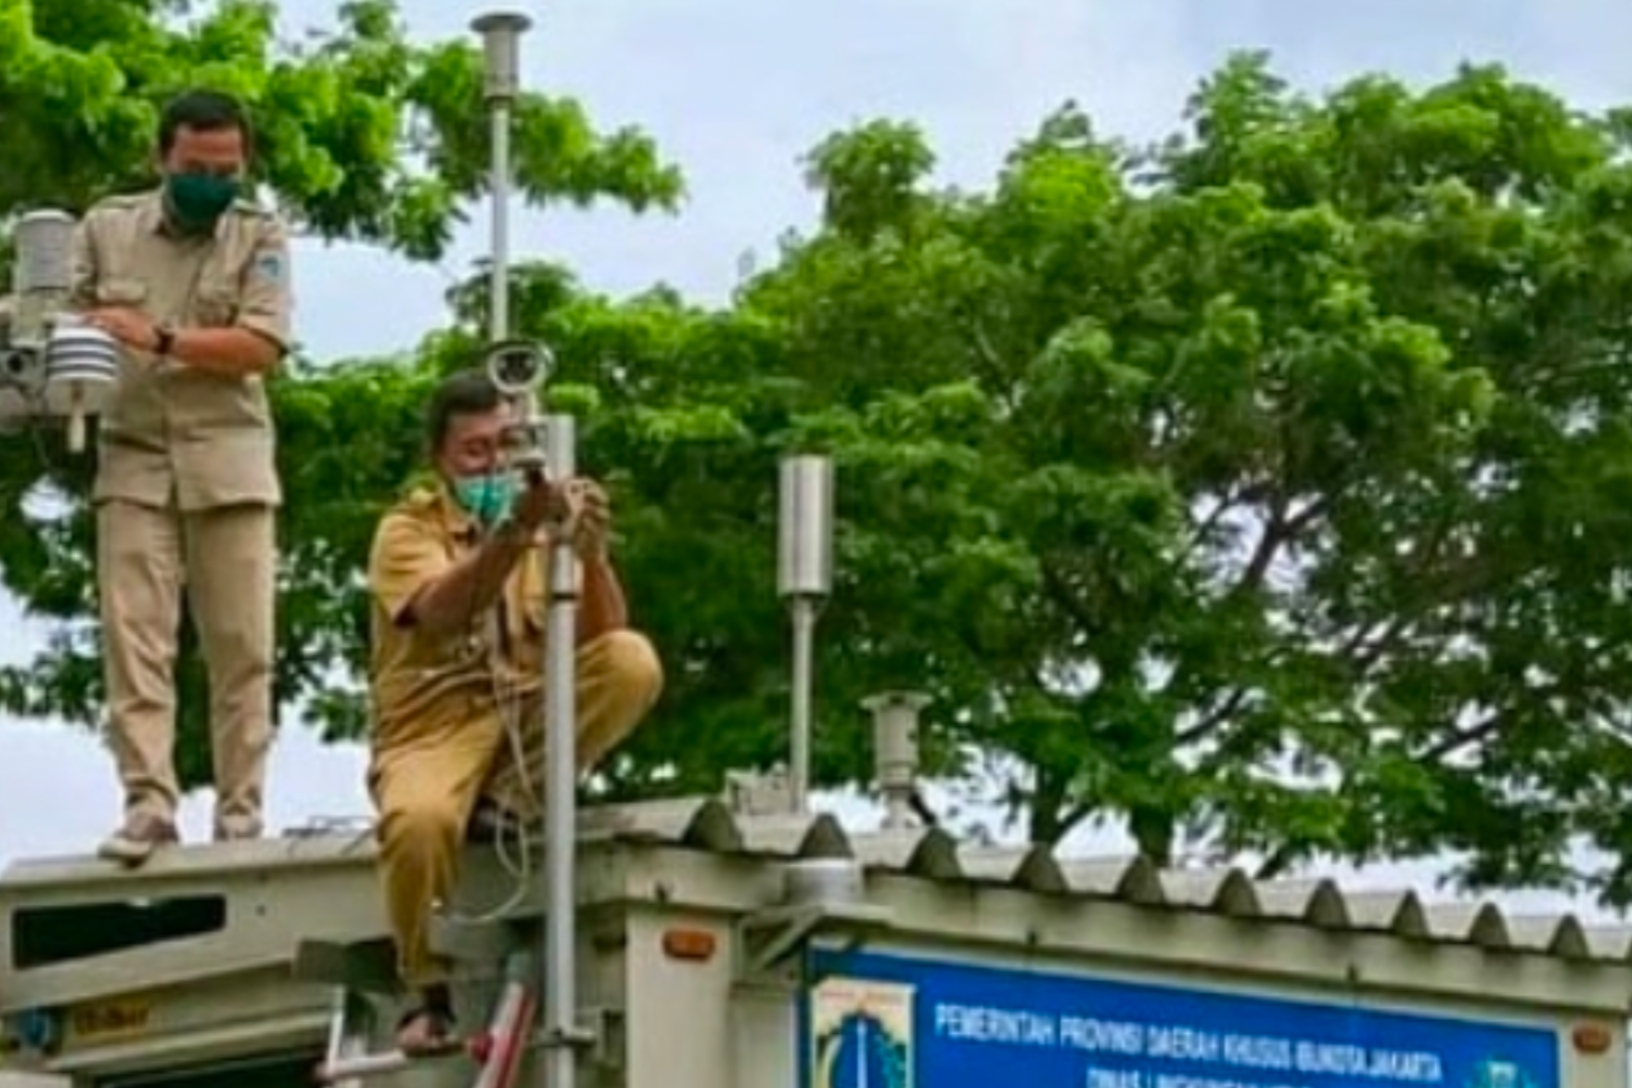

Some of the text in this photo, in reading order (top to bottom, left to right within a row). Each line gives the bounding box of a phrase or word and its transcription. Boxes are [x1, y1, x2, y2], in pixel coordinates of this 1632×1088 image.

[934, 1002, 1055, 1045] PEMERINTAH
[1060, 1014, 1143, 1055] PROVINSI
[1147, 1023, 1220, 1063] DAERAH
[1224, 1033, 1291, 1071] KHUSUS
[1370, 1049, 1442, 1084] JAKARTA
